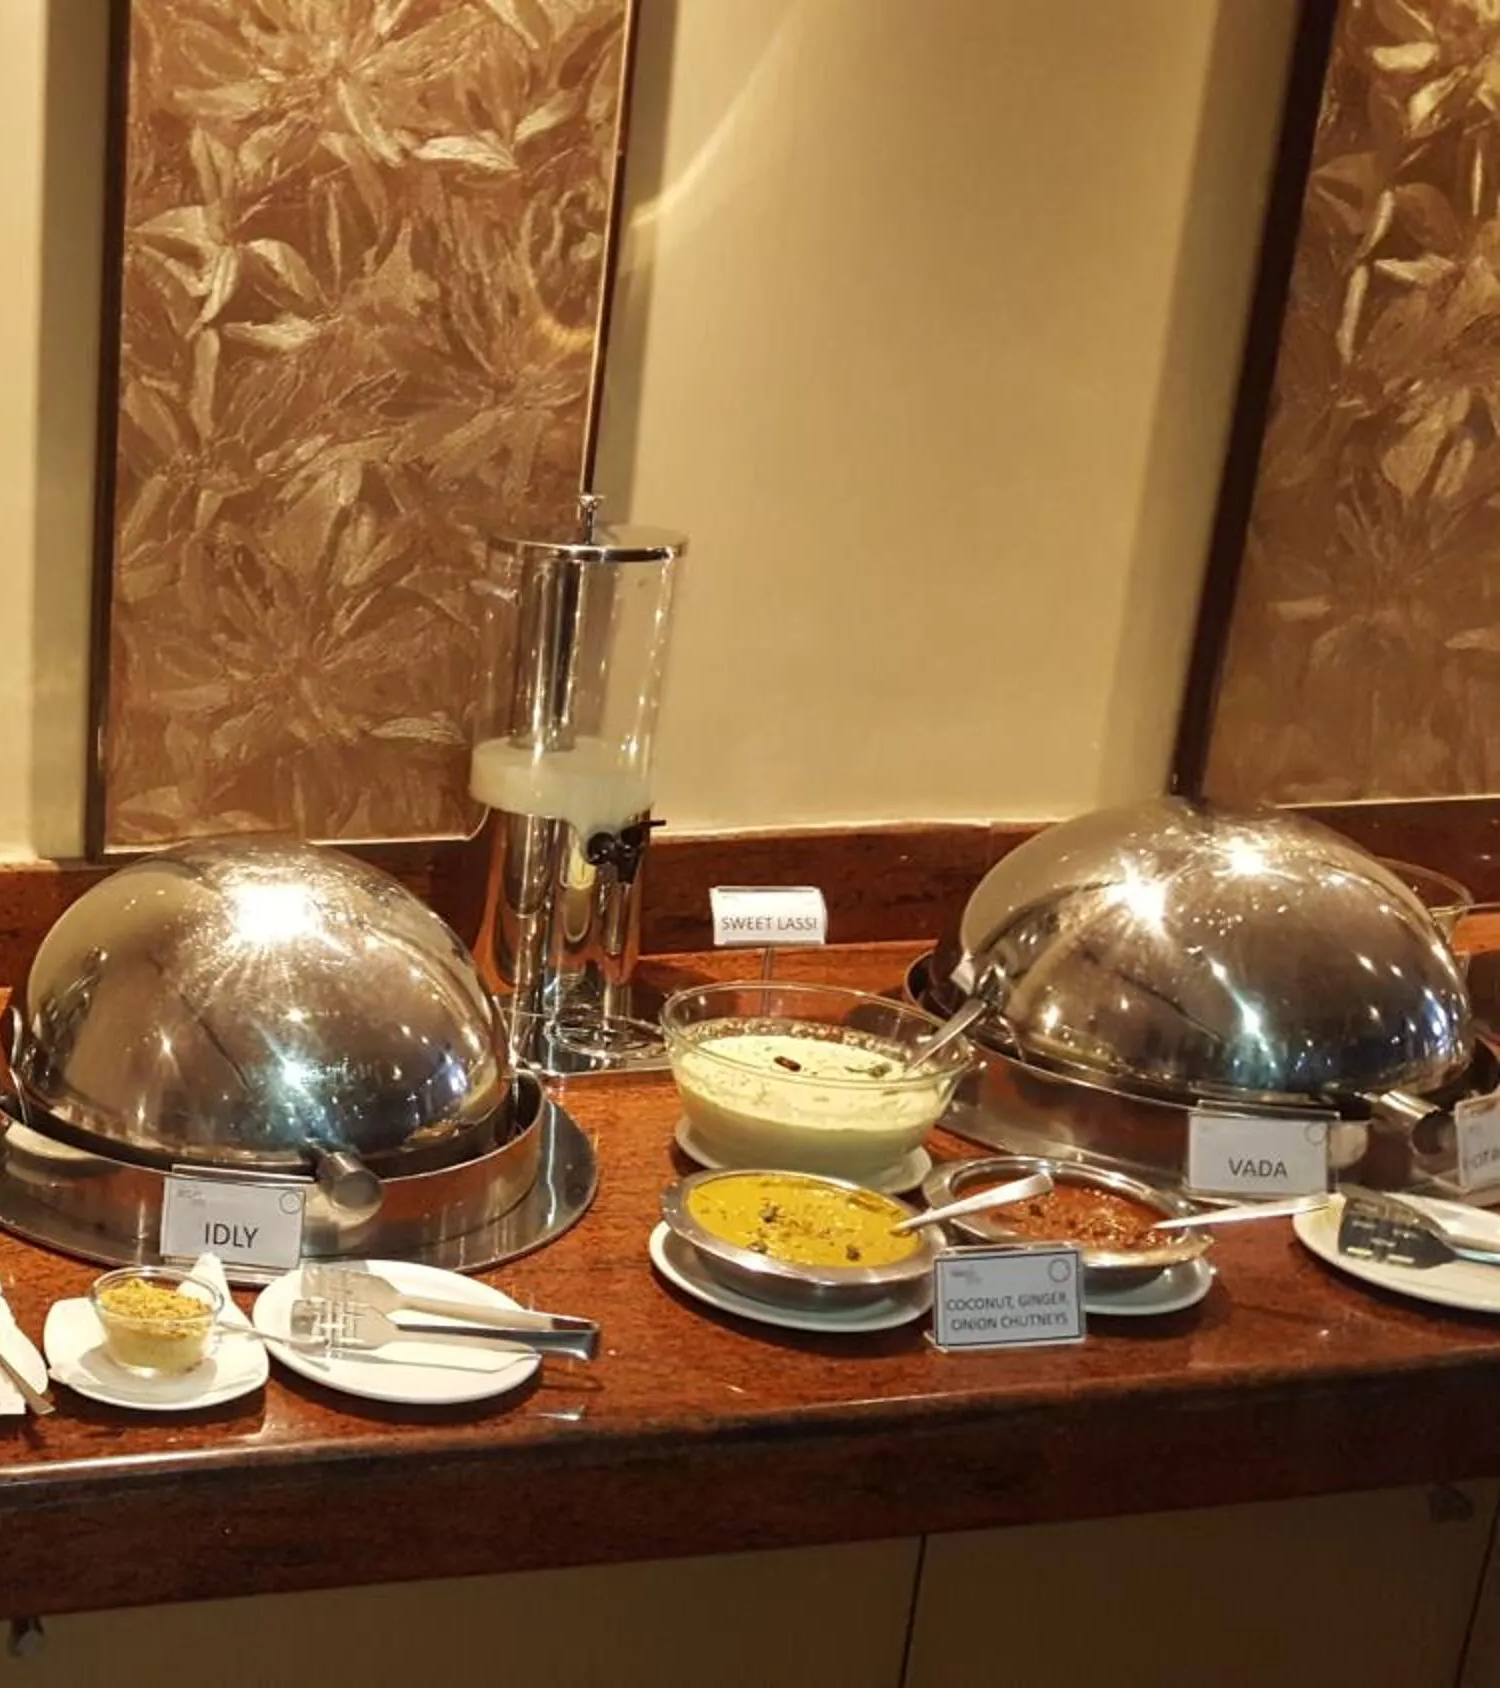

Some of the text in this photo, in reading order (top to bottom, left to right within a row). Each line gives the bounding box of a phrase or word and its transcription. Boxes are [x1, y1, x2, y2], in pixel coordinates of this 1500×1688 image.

[721, 915, 818, 931] SWEET LASSI
[1228, 1158, 1288, 1178] VADA
[205, 1222, 260, 1249] IDLY
[946, 1295, 1015, 1312] COCONUT,
[951, 1312, 1068, 1332] ONION CHUTNEYS
